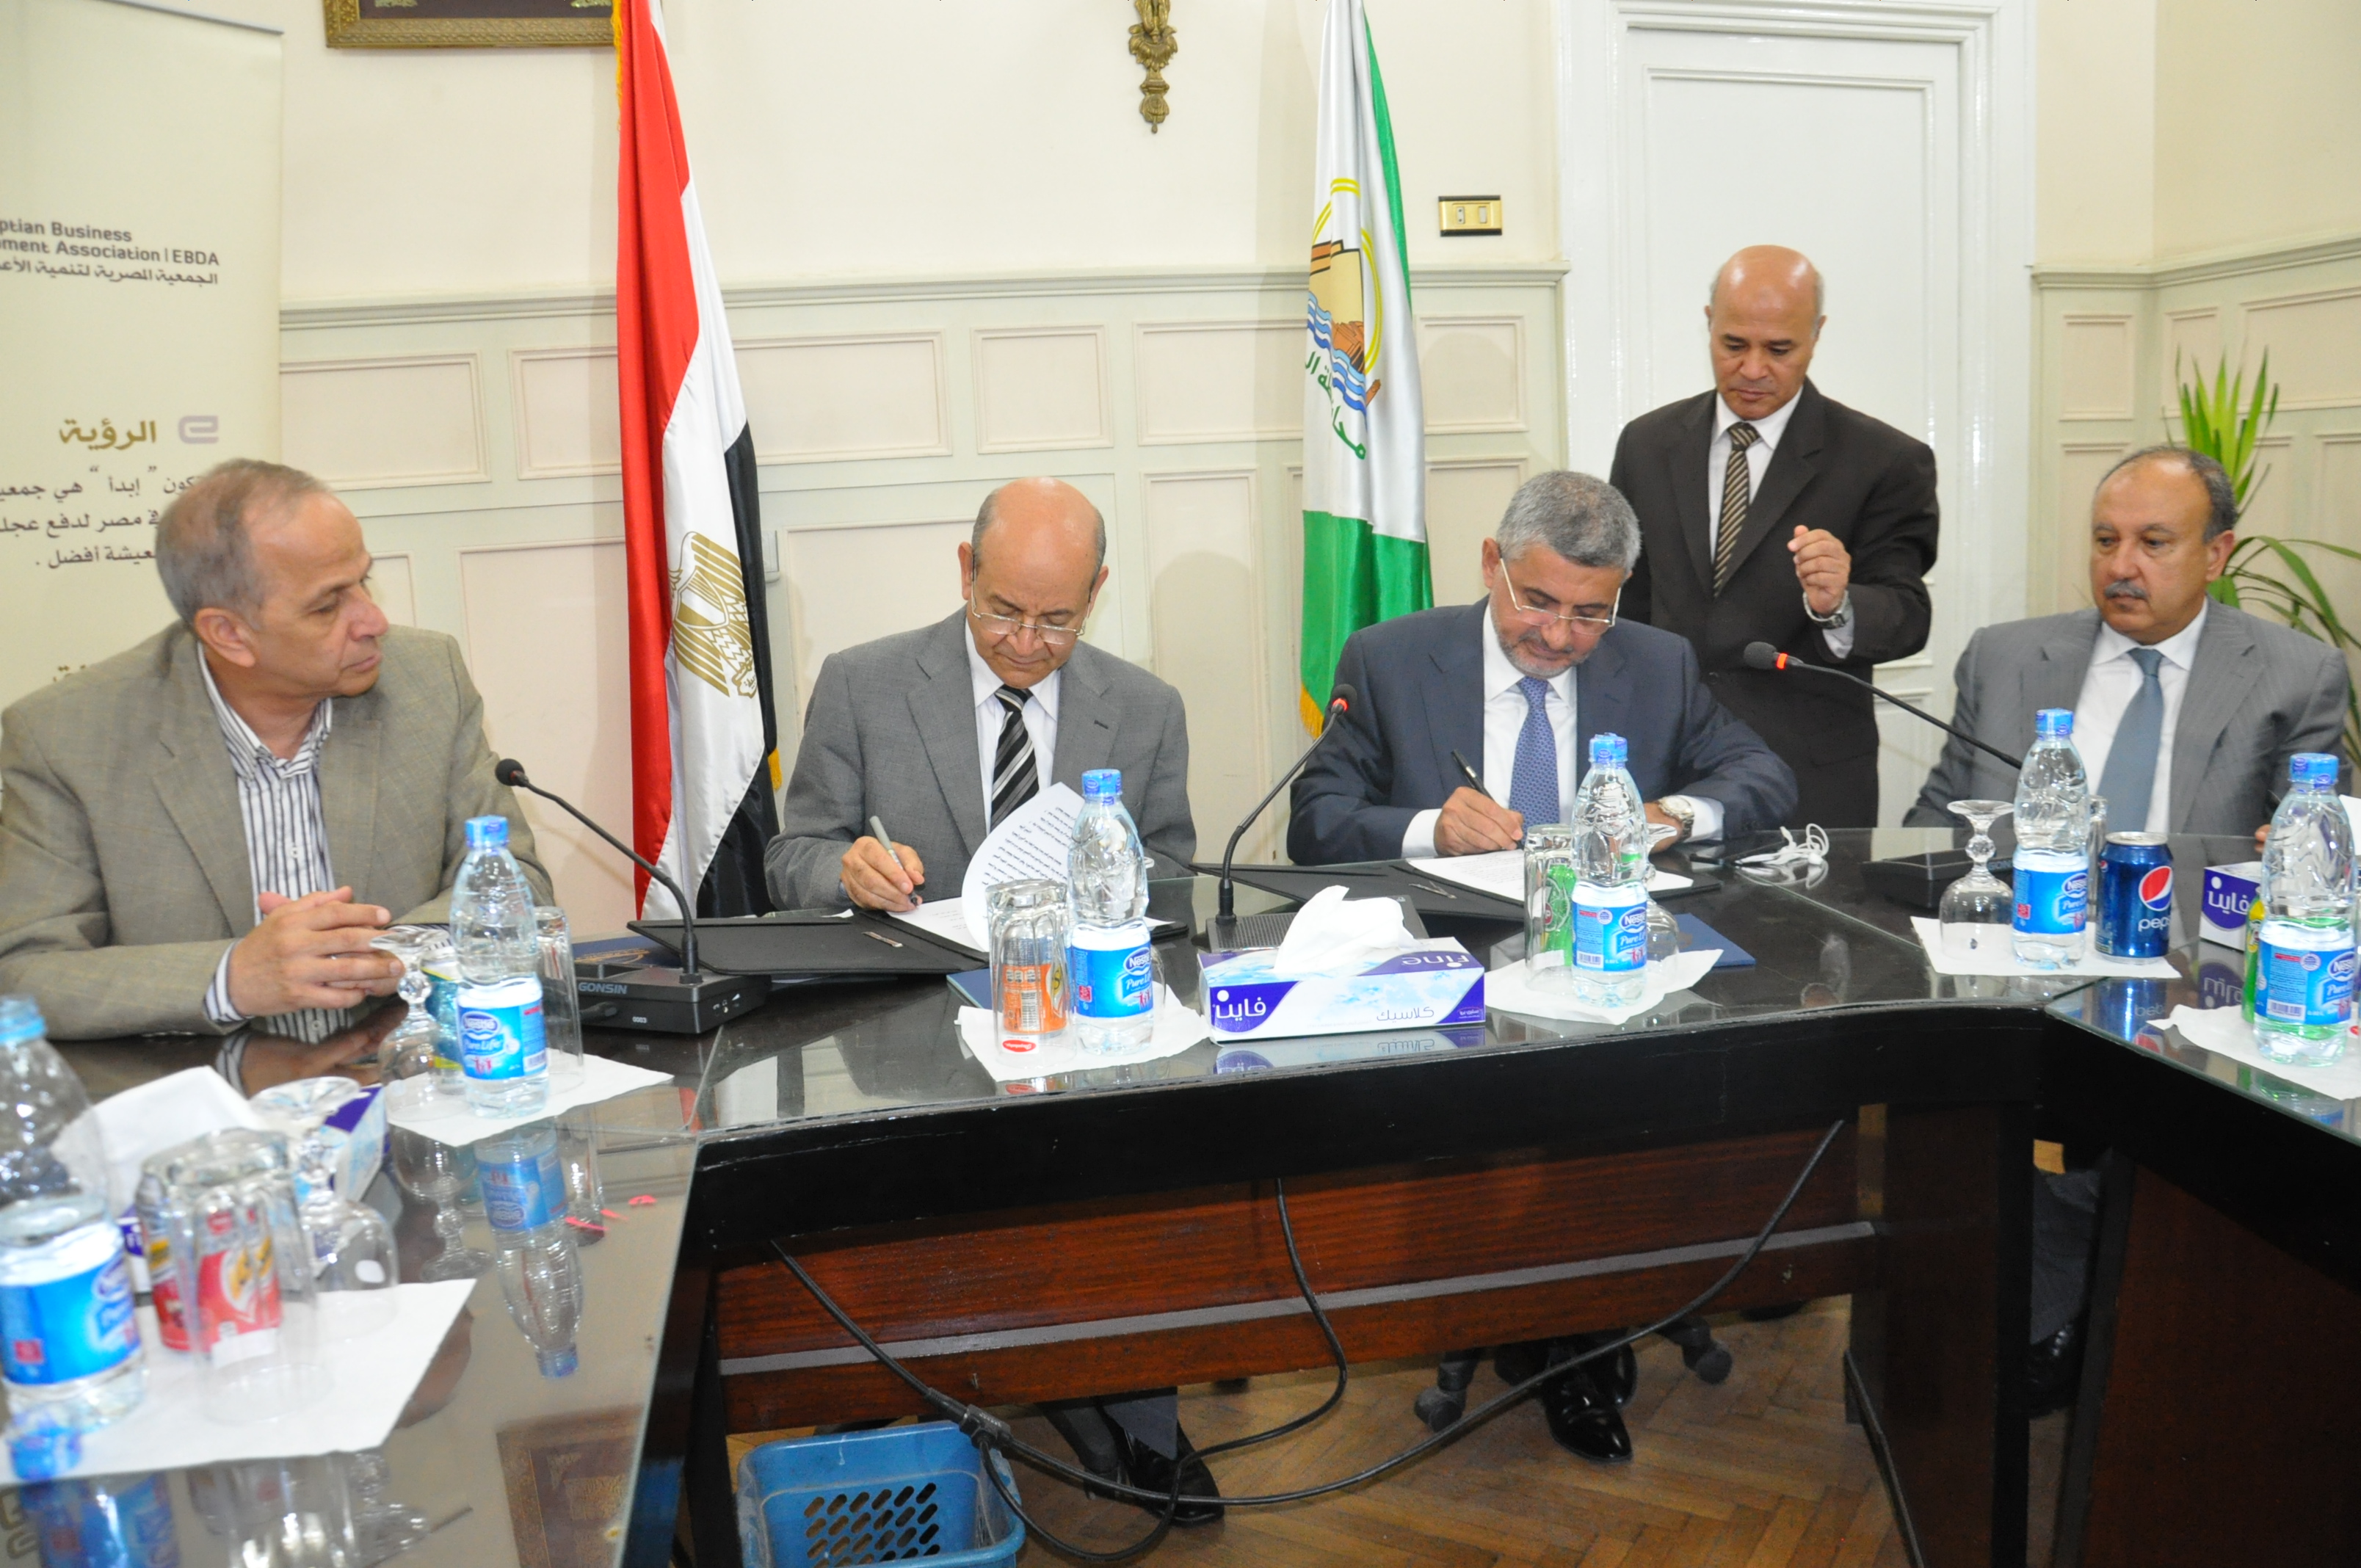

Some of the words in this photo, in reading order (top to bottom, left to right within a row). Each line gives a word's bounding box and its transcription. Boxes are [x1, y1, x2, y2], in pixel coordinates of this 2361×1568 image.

[51, 221, 132, 242] Business
[0, 239, 50, 253] ment
[56, 241, 160, 261] Association
[173, 249, 220, 266] EBDA
[0, 256, 31, 273] الأع
[35, 261, 90, 278] لتنمية
[95, 264, 153, 283] المصرية
[156, 269, 218, 287] الجمعية
[59, 418, 157, 451] الرؤية
[0, 484, 46, 502] جمعي
[54, 481, 84, 503] هي
[0, 516, 39, 537] عجل
[46, 513, 90, 538] لدفع
[95, 515, 142, 533] مصر
[48, 545, 100, 569] أفضل
[104, 545, 156, 565] عيشة
[2138, 916, 2171, 932] pep
[578, 981, 628, 995] GONSIN
[1215, 989, 1267, 1022] فاين
[1377, 1006, 1435, 1023] كلاسيك
